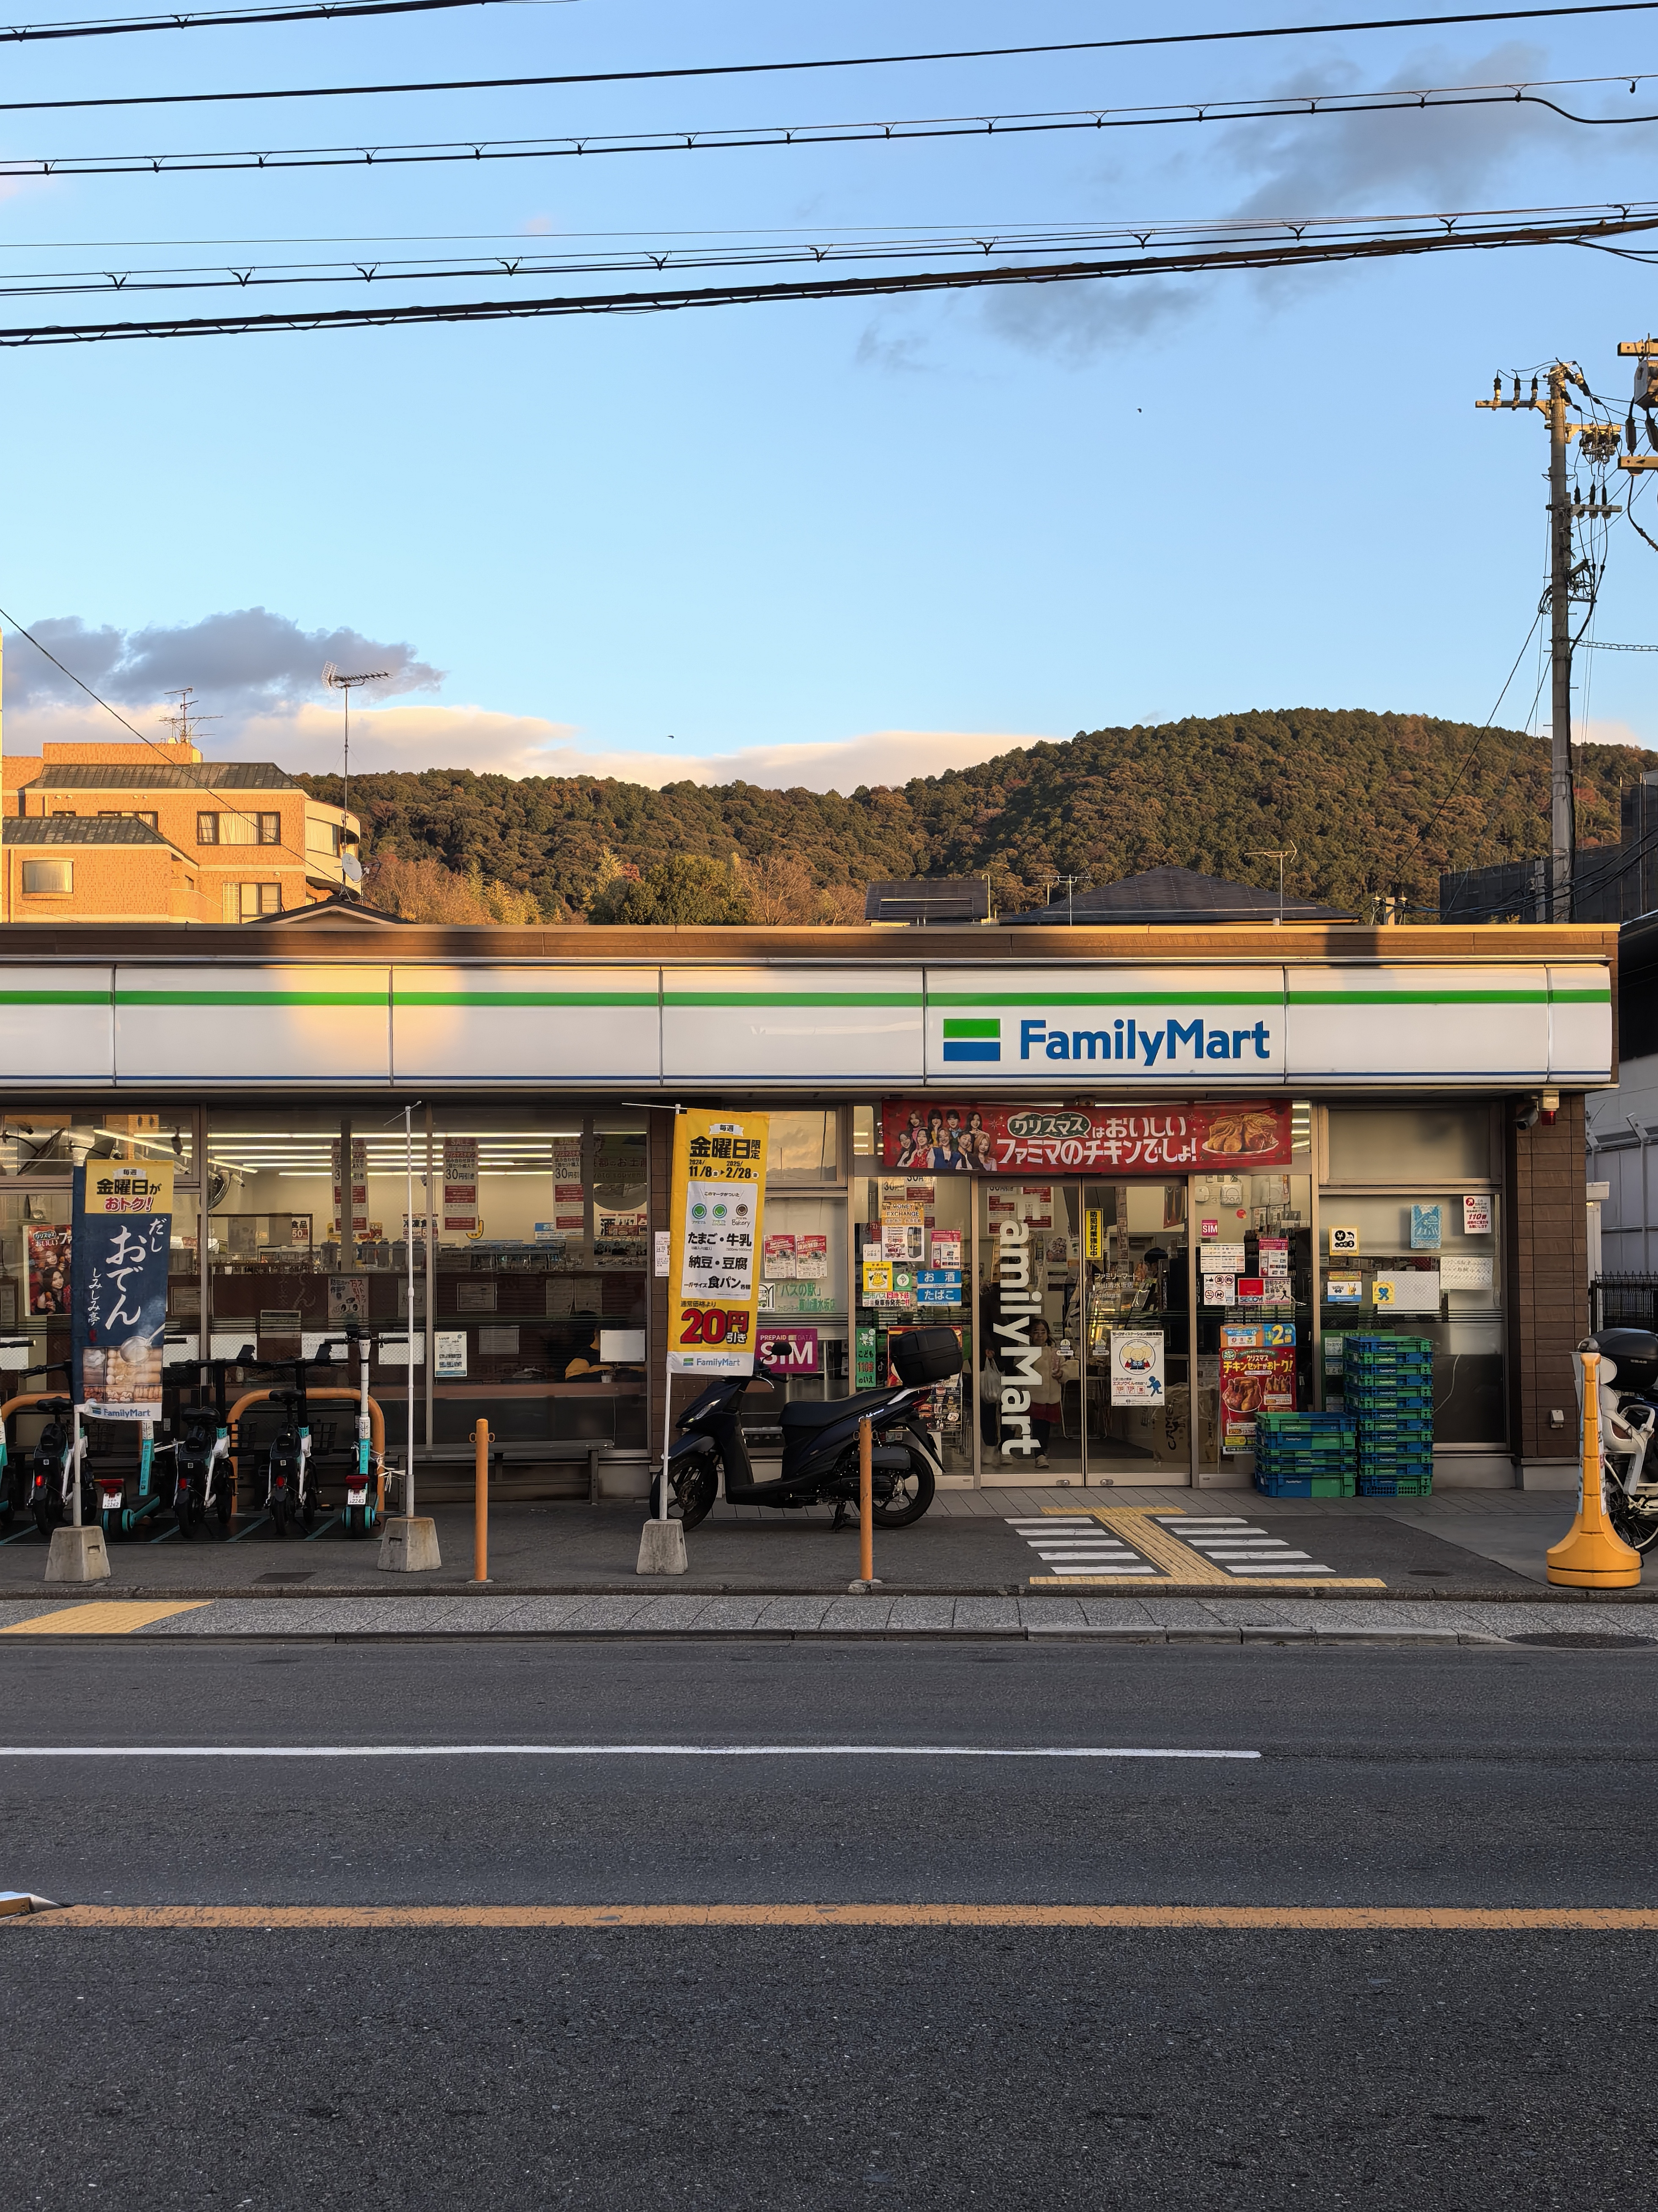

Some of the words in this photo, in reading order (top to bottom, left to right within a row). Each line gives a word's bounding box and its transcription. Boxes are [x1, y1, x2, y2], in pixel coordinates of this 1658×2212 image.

[1020, 1019, 1270, 1066] FamilyMart
[719, 1124, 734, 1132] 毎週
[1014, 1117, 1185, 1139] クリスマスはおいしい
[997, 1137, 1197, 1165] ファミマのチキンでしょ!
[446, 1169, 474, 1180] 30円引き
[689, 1166, 712, 1177] 11/8
[726, 1167, 752, 1179] 2/28
[96, 1178, 162, 1195] 金曜日が
[104, 1196, 154, 1212] おトク!
[732, 1219, 751, 1229] Bakery
[1202, 1225, 1218, 1233] SIM
[149, 1218, 167, 1252] だし
[688, 1232, 752, 1247] たまご・牛乳
[689, 1255, 748, 1270] 納豆・豆腐
[105, 1225, 147, 1330] おでん
[1094, 1273, 1139, 1284] ファミリーマート
[88, 1267, 102, 1326] しみしみ亭
[924, 1290, 955, 1301] たばこ
[993, 1194, 1042, 1455] FamilyMart
[697, 1358, 740, 1367] FamilyMart
[1223, 1360, 1294, 1374] チキンセットがおトク!
[104, 1409, 151, 1418] FamilyMart
